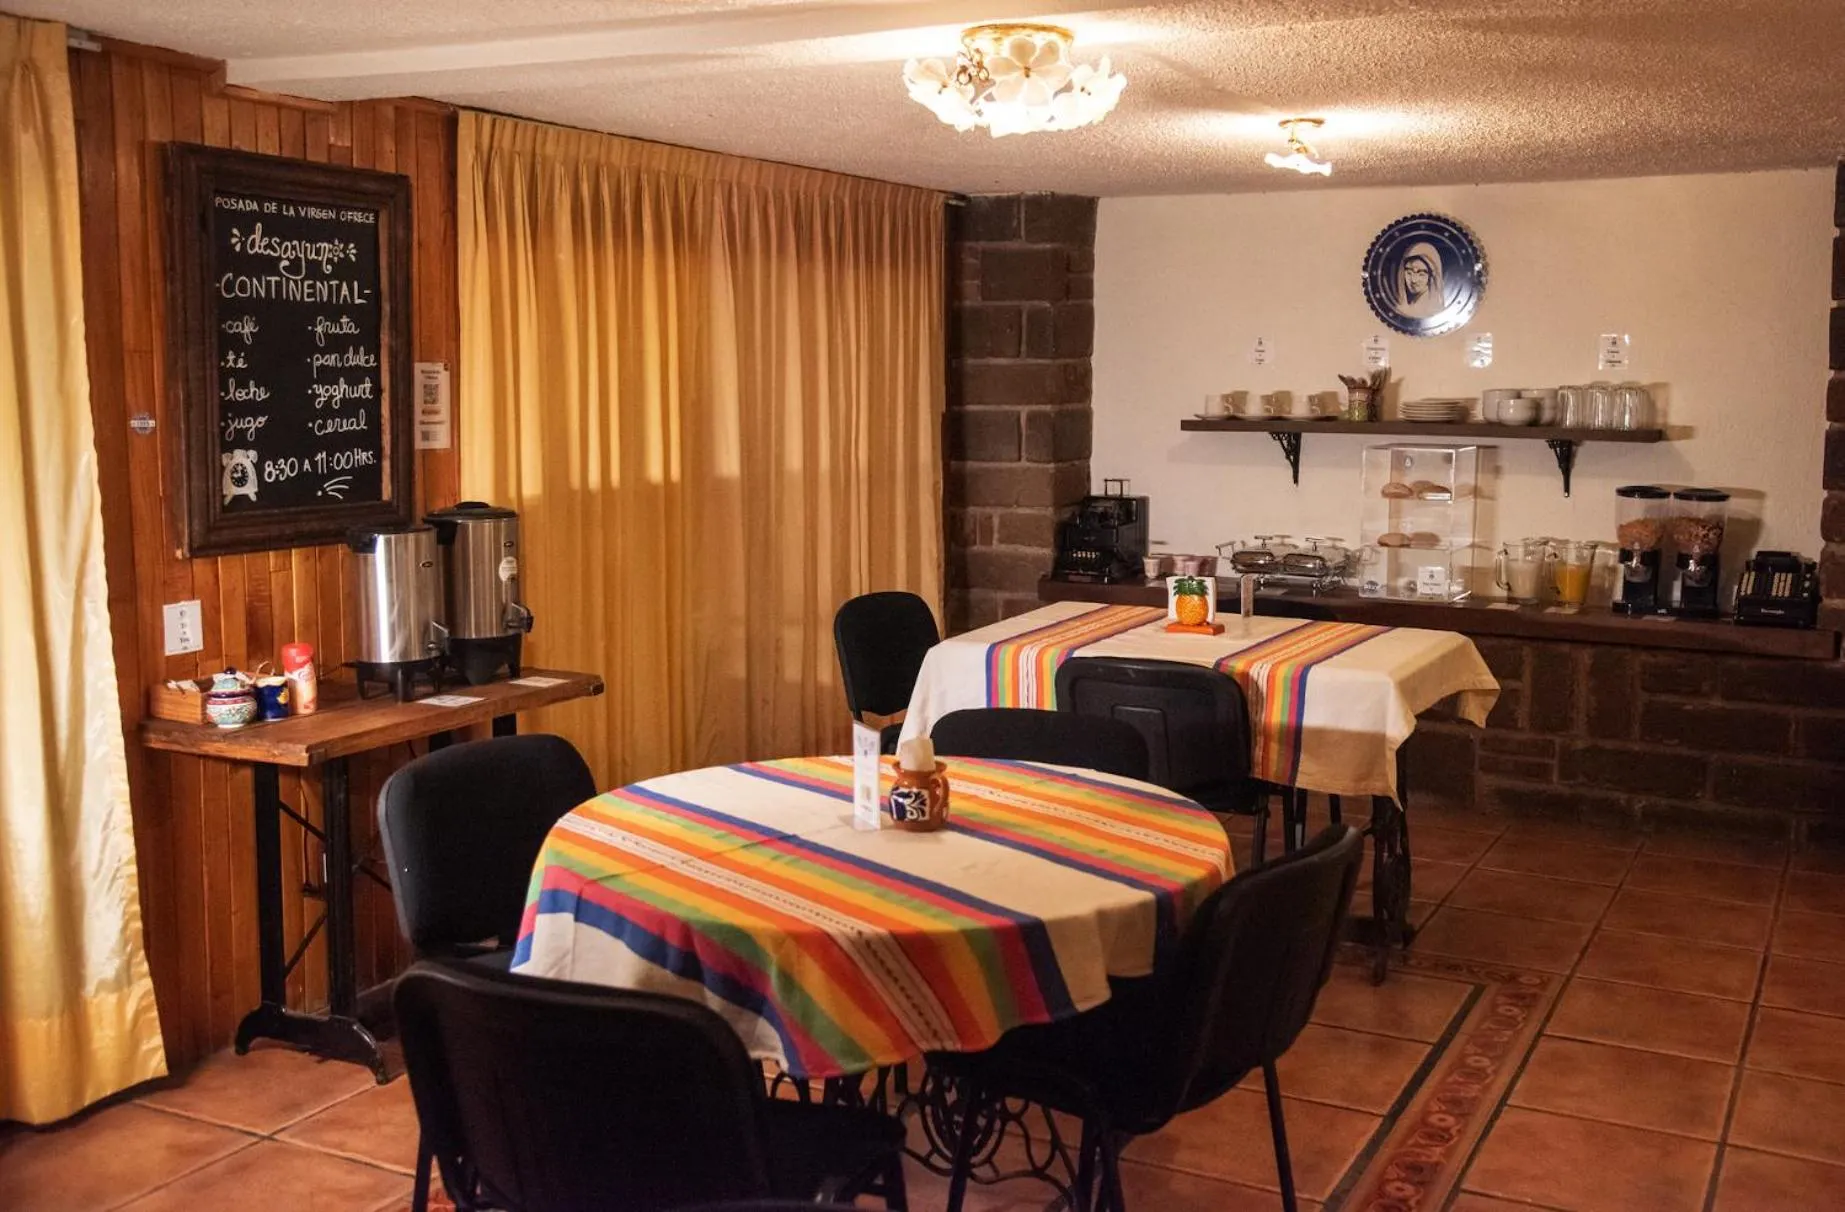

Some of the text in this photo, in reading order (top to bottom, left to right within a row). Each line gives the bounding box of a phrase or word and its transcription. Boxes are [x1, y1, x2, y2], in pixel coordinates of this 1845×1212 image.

[215, 197, 375, 224] POSADA DE LA VIRGEN OFRECE
[225, 316, 259, 344] café
[315, 316, 359, 346] fruta
[226, 351, 248, 369] té
[313, 346, 377, 378] pan dulce
[312, 377, 374, 408] yoghurt
[225, 412, 268, 442] jugo
[314, 409, 368, 436] cereal
[264, 457, 299, 482] 8:30
